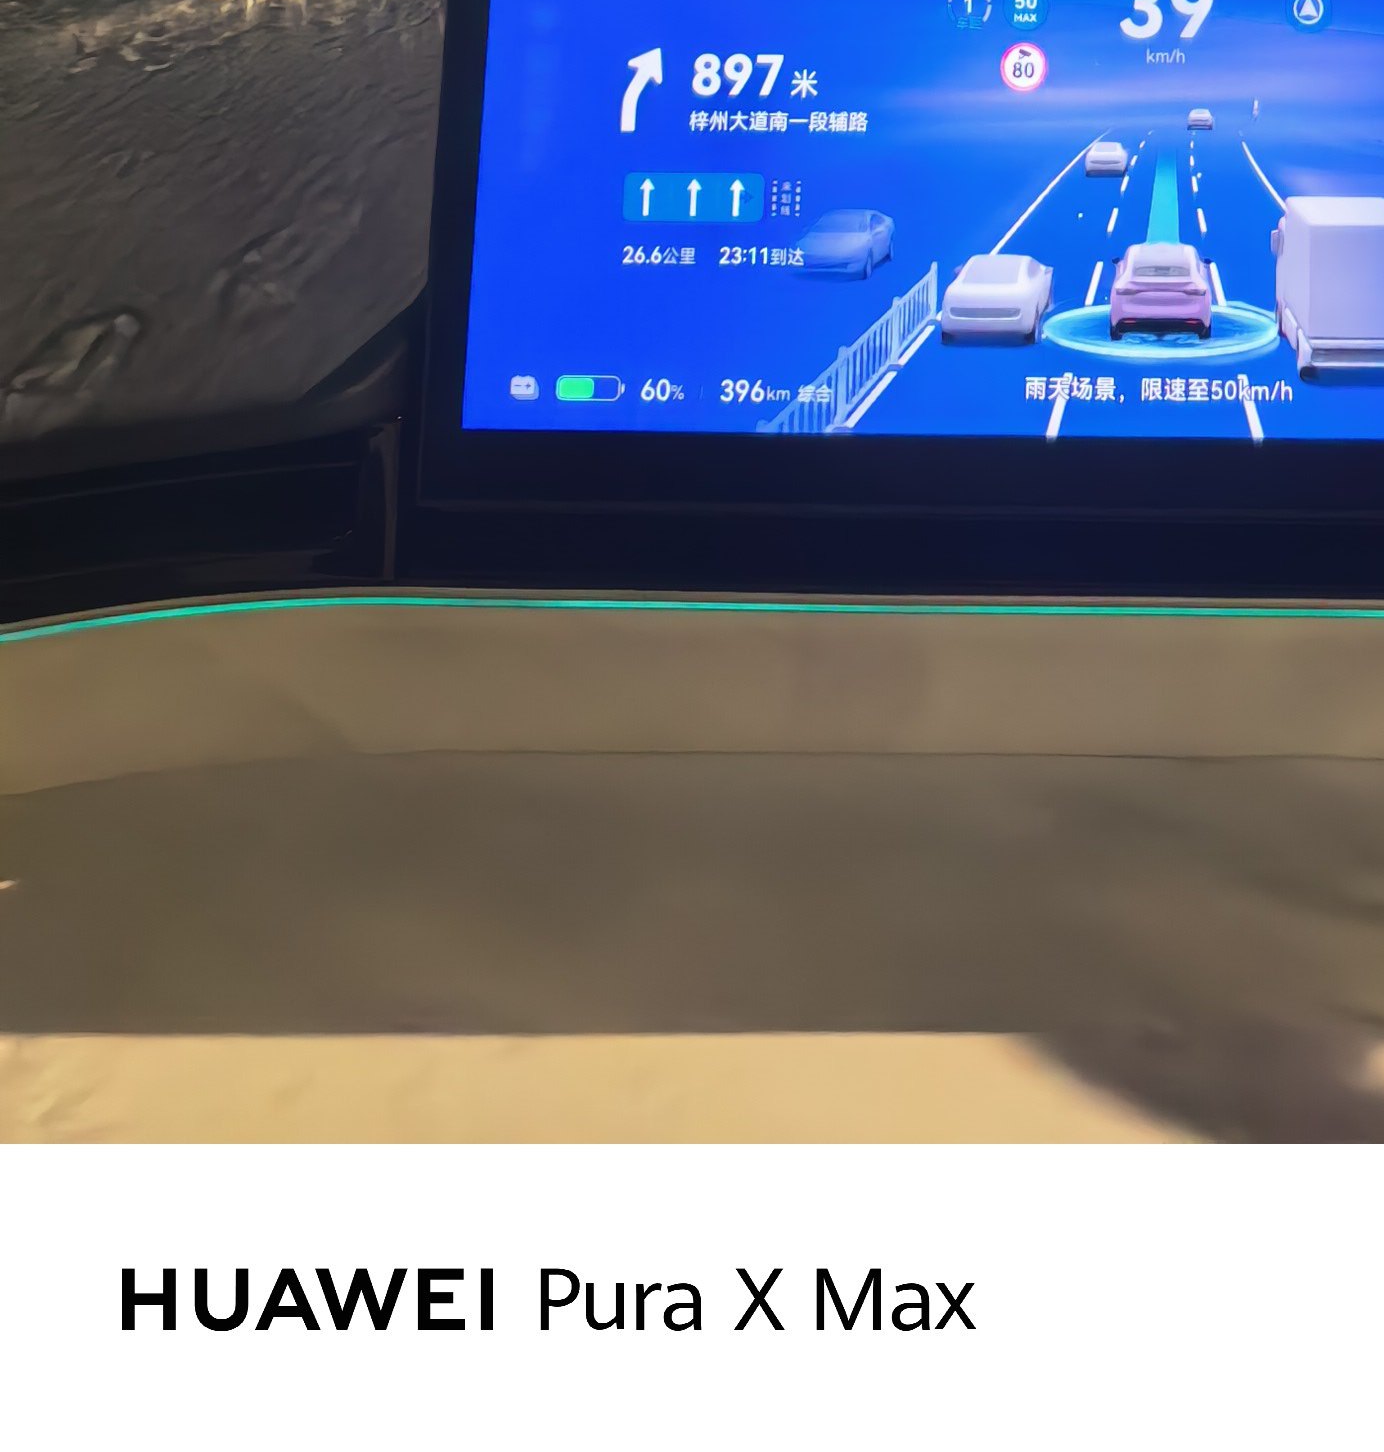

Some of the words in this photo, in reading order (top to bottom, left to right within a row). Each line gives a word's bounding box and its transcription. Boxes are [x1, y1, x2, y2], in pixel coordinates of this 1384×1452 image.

[1013, 13, 1038, 23] MAX
[1145, 47, 1186, 65] km/h
[691, 52, 785, 97] 897
[790, 68, 819, 99] 米
[1012, 62, 1035, 79] 80
[688, 109, 870, 133] 梓州大道南一段辅路
[621, 244, 697, 266] 26.6公里
[718, 245, 806, 267] 23:11到达
[639, 378, 686, 403] 60%
[719, 378, 792, 404] 396km
